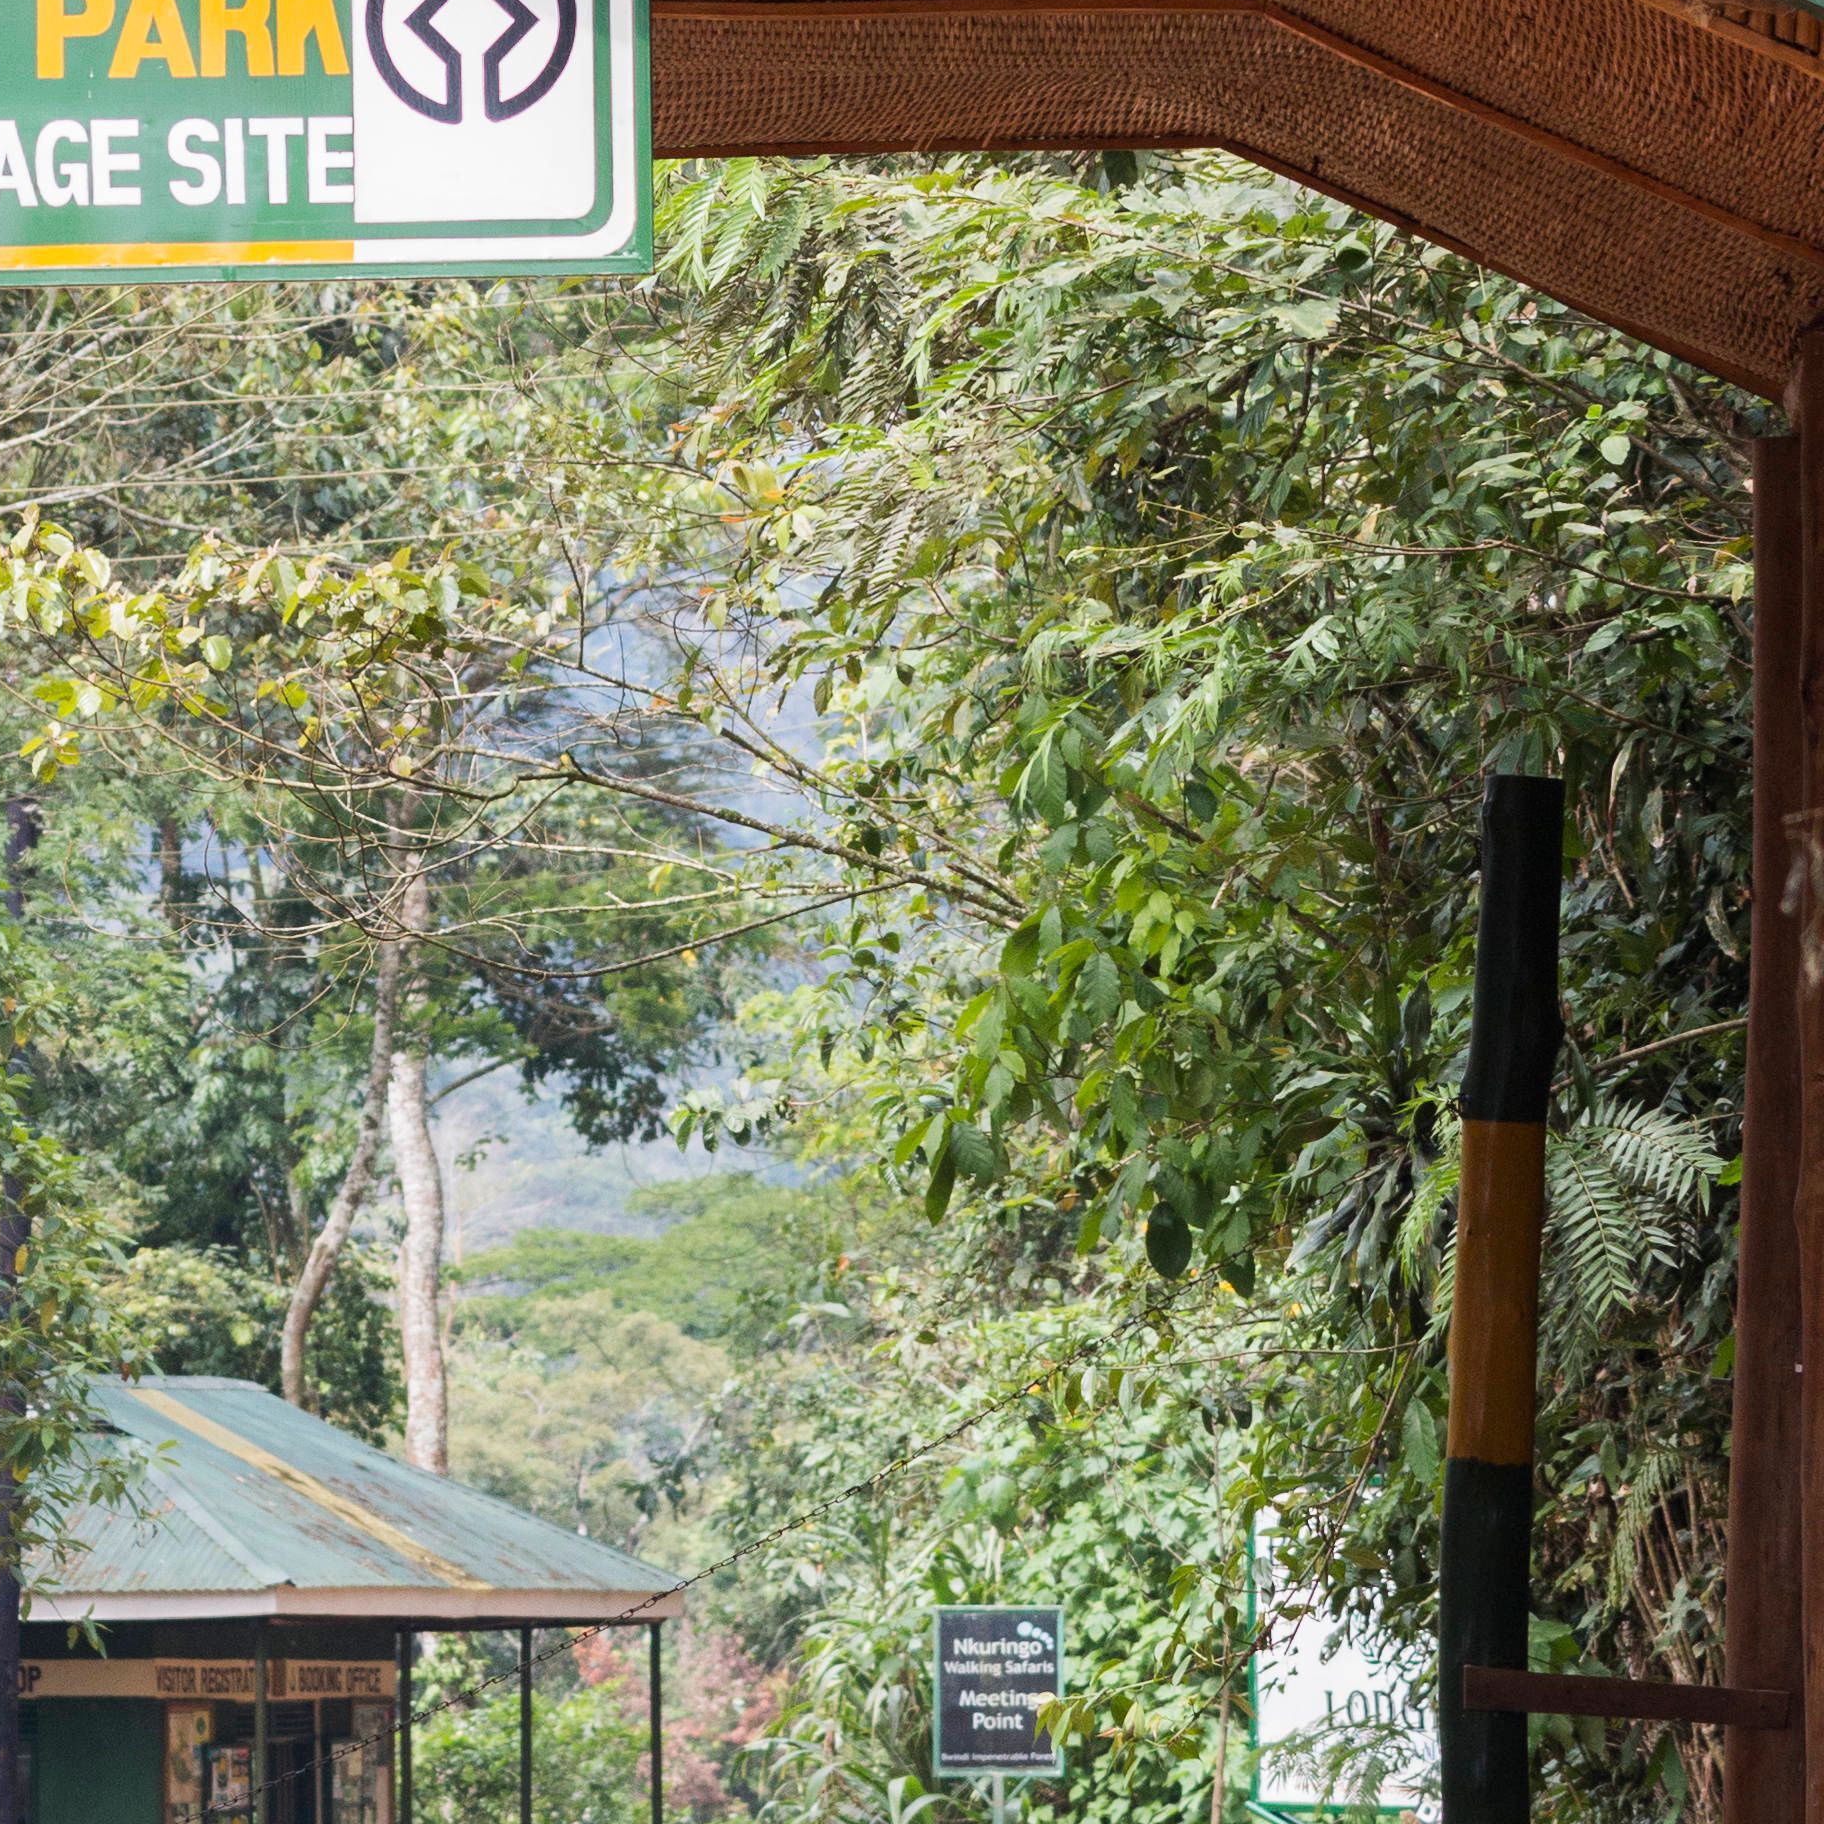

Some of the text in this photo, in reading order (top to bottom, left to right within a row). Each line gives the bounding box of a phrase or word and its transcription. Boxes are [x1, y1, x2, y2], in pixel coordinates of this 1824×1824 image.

[168, 116, 355, 206] SITE
[953, 1637, 1043, 1659] Nkuringo
[943, 1660, 1055, 1676] Walking Safaris
[298, 1666, 342, 1693] BOOKING
[347, 1666, 382, 1693] OFFICE
[959, 1689, 1039, 1710] Meeting
[972, 1712, 1024, 1730] Point
